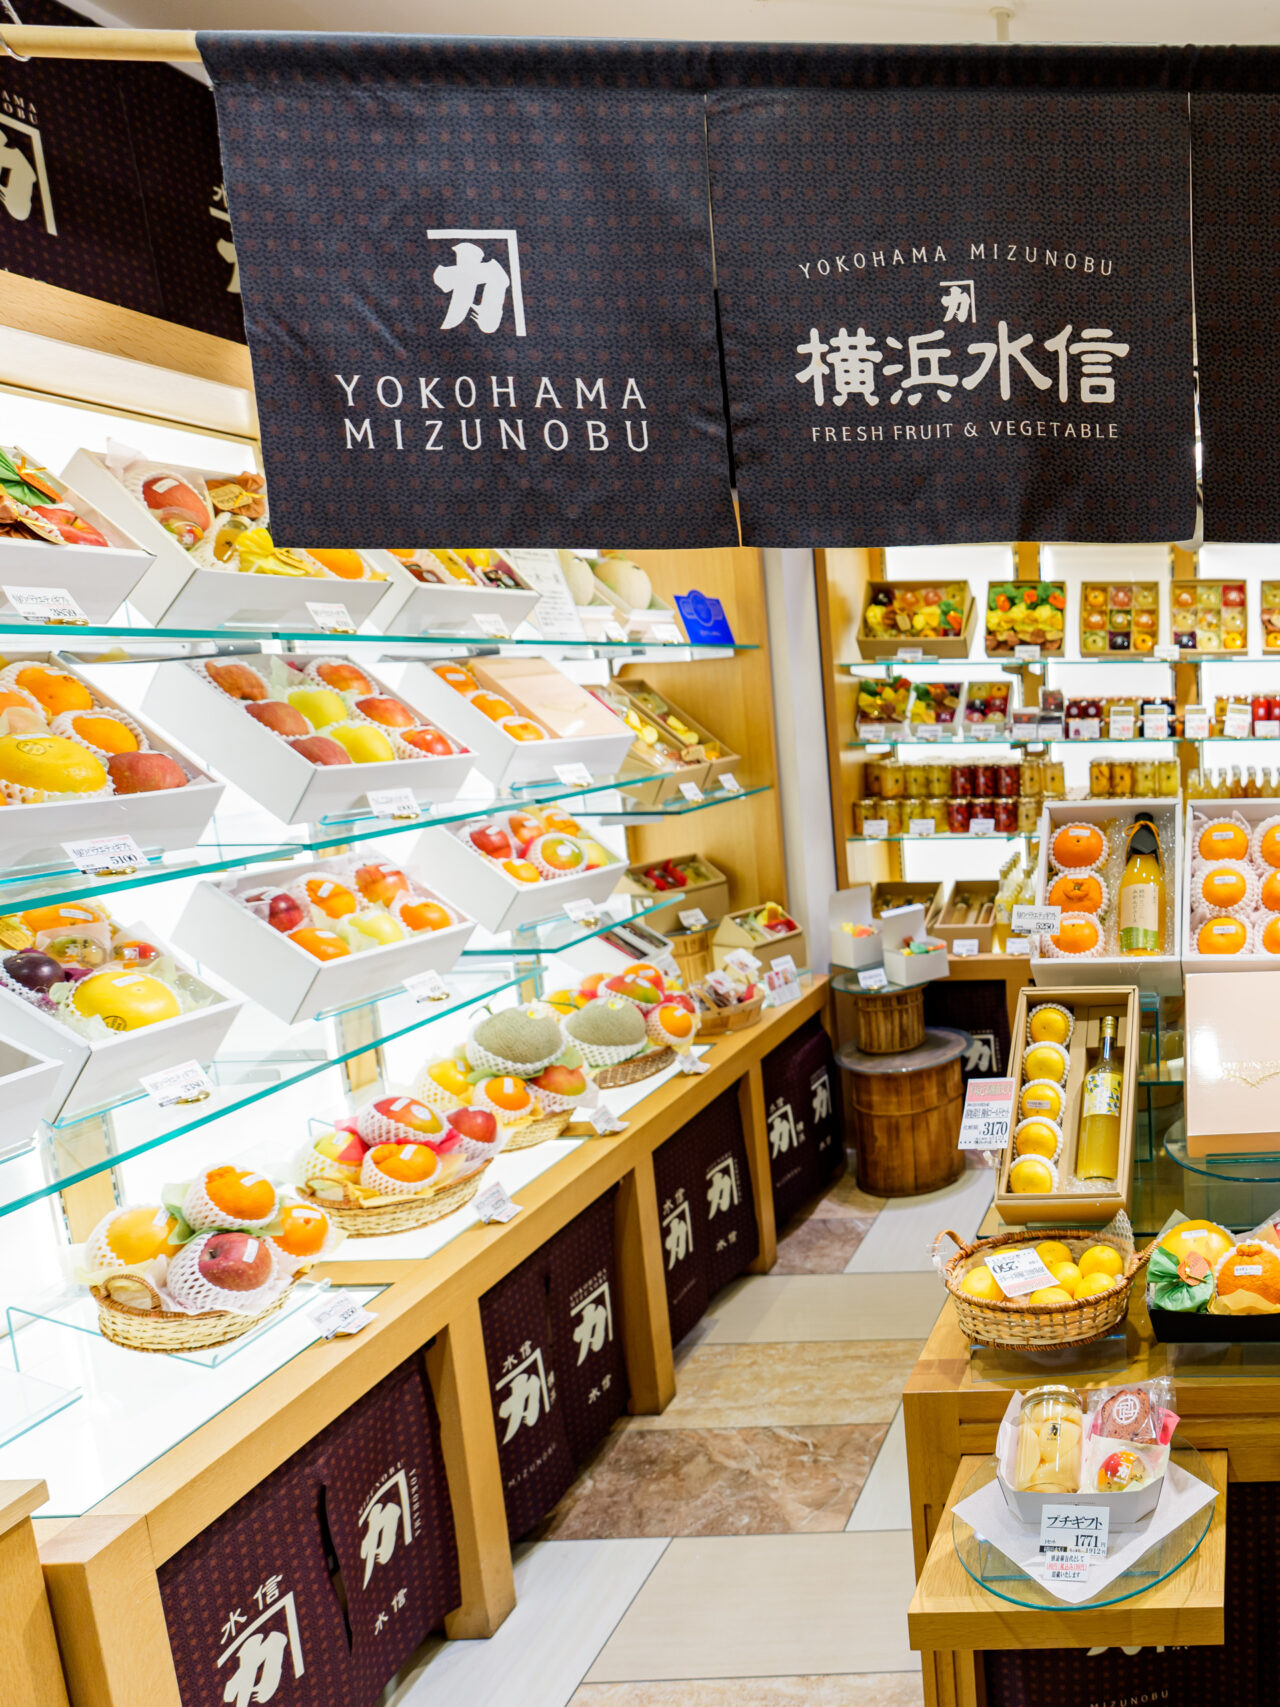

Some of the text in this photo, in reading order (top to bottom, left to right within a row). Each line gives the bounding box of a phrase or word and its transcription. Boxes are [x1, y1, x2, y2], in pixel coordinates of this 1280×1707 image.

[799, 243, 1113, 280] YOKOHAMA MIZUNOBU
[795, 320, 1130, 406] 横浜水信
[335, 374, 647, 410] YOKOHAMA
[344, 418, 649, 452] MIZUNOBU
[811, 420, 1119, 442] FRESH FRUIT & VEGETABLE
[982, 1121, 1008, 1136] 3170
[1047, 1514, 1103, 1530] プチギフト
[1074, 1534, 1098, 1547] 1771
[220, 1573, 283, 1645] 水信
